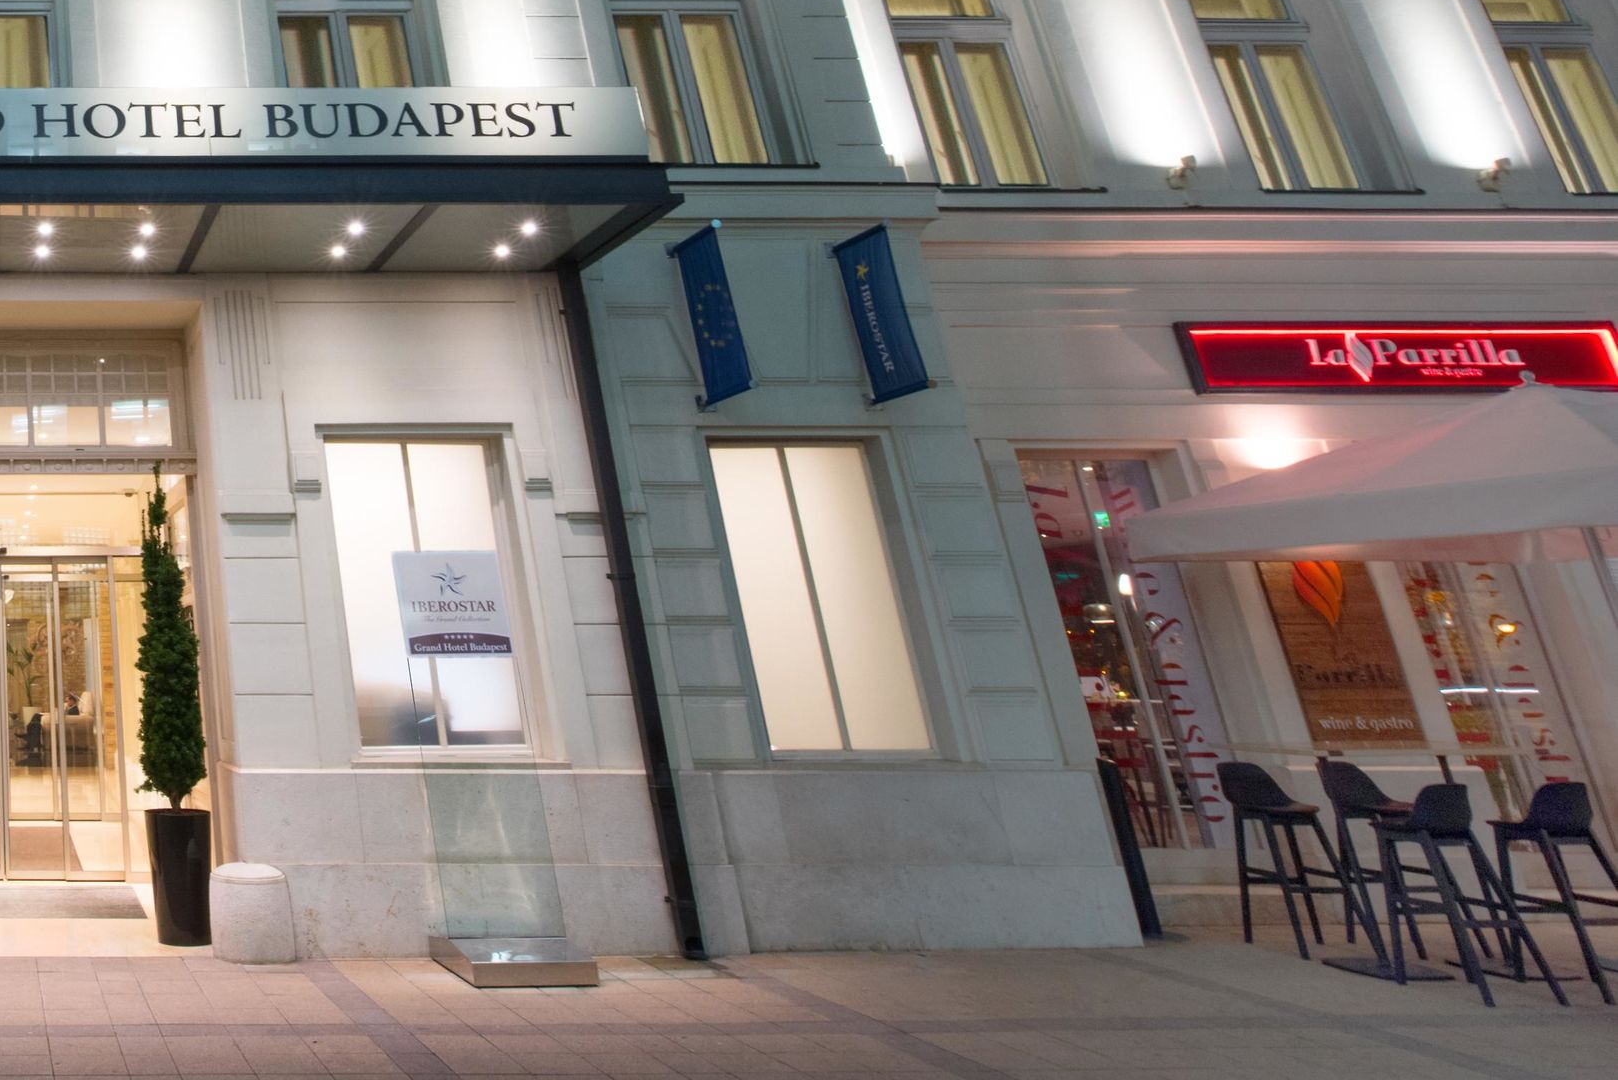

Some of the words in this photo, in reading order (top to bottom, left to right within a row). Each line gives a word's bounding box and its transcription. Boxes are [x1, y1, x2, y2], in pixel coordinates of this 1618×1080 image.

[33, 102, 242, 139] HOTEL
[264, 101, 576, 138] BUDAPEST
[859, 283, 895, 373] IBEROSTAR
[1304, 339, 1348, 366] La
[1368, 338, 1526, 366] Parrilla
[411, 600, 496, 613] IBEROSTAR
[414, 642, 442, 652] Grand
[444, 642, 468, 652] Hotel
[470, 643, 508, 653] Budapest
[1318, 716, 1353, 729] wine
[1356, 715, 1369, 730] &
[1370, 715, 1414, 732] gastro
